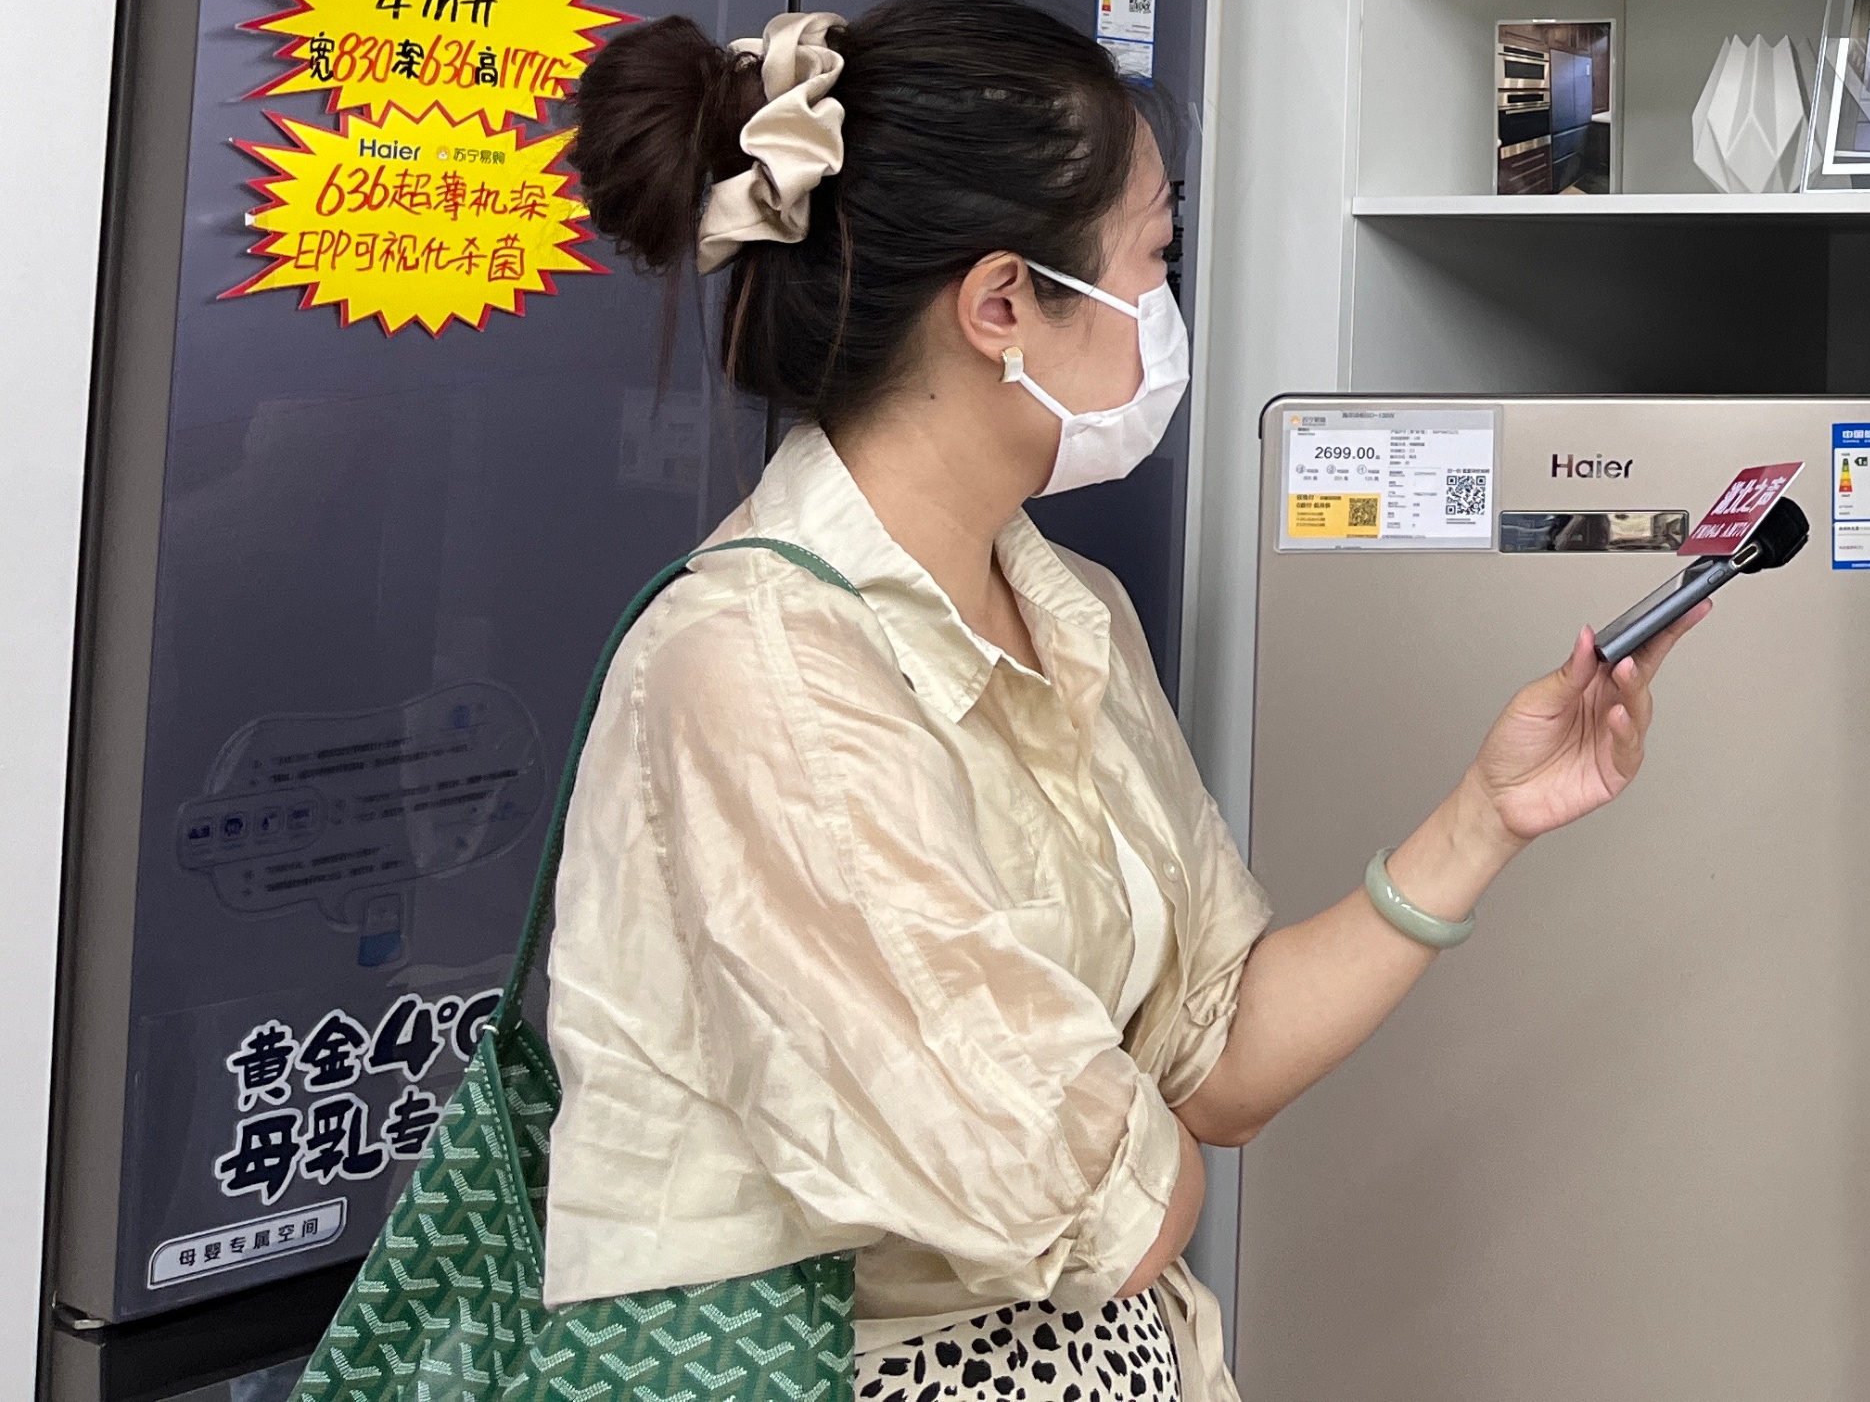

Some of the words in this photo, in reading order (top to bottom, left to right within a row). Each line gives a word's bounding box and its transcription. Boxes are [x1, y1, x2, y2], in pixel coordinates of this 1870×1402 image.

[359, 138, 421, 162] Haier
[453, 147, 506, 165] 苏宁易购
[293, 230, 525, 282] EPP可视化杀菌
[1551, 452, 1634, 480] Haier
[178, 1217, 320, 1268] 母婴专属空间
